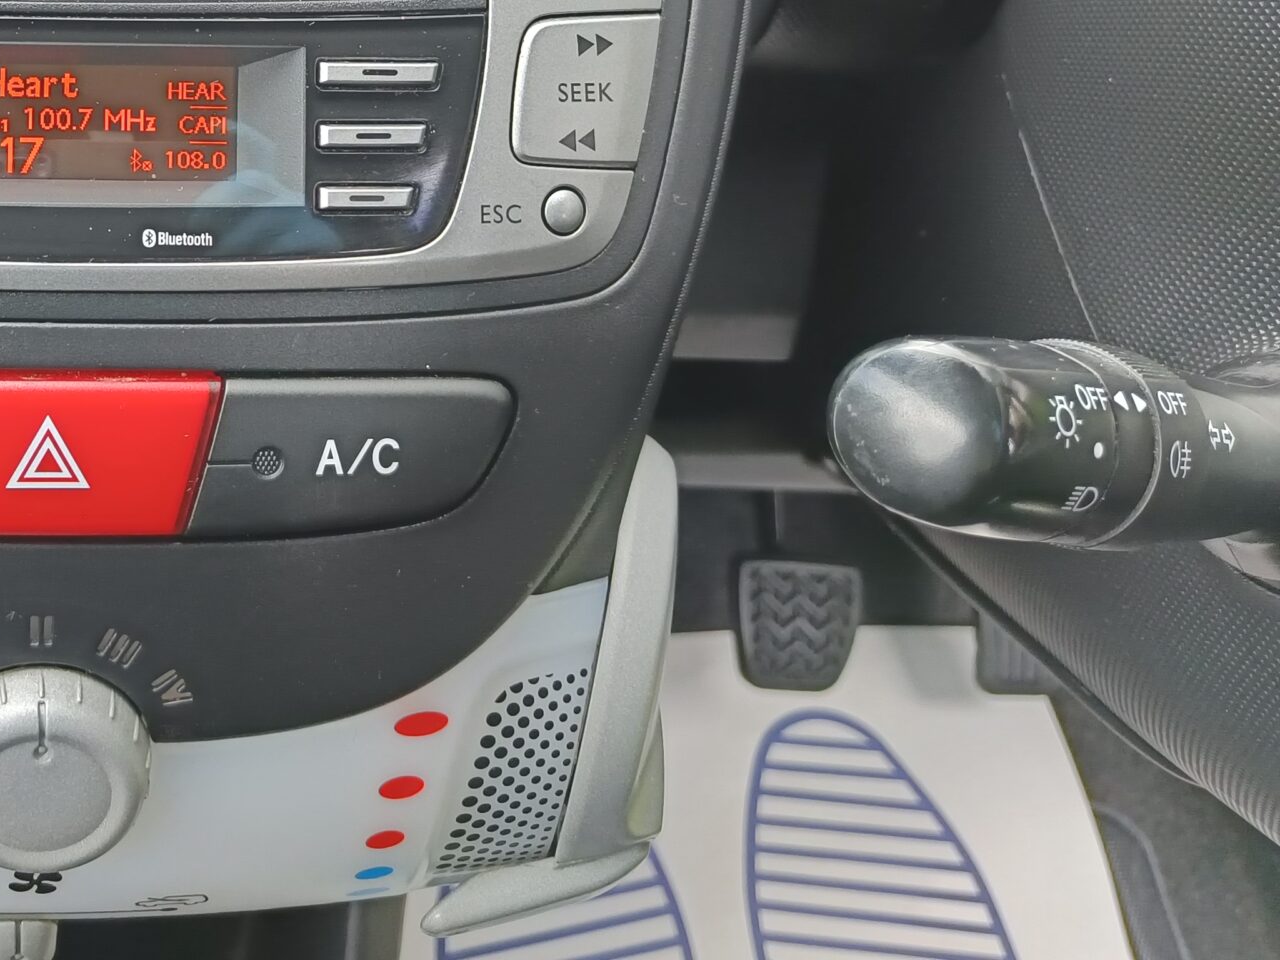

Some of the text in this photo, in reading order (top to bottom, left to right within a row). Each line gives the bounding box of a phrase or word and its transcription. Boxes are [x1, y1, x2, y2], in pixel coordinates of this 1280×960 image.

[167, 81, 226, 102] HEAR
[557, 82, 613, 103] SEEK
[24, 107, 93, 132] 100.7
[104, 109, 156, 133] MHz
[179, 115, 227, 136] CAPI
[166, 150, 226, 171] 108.0
[480, 204, 522, 225] ESC
[158, 229, 213, 249] Bluetooth
[1074, 384, 1108, 411] OFF
[1157, 391, 1187, 416] OFF
[316, 437, 401, 476] A/C
